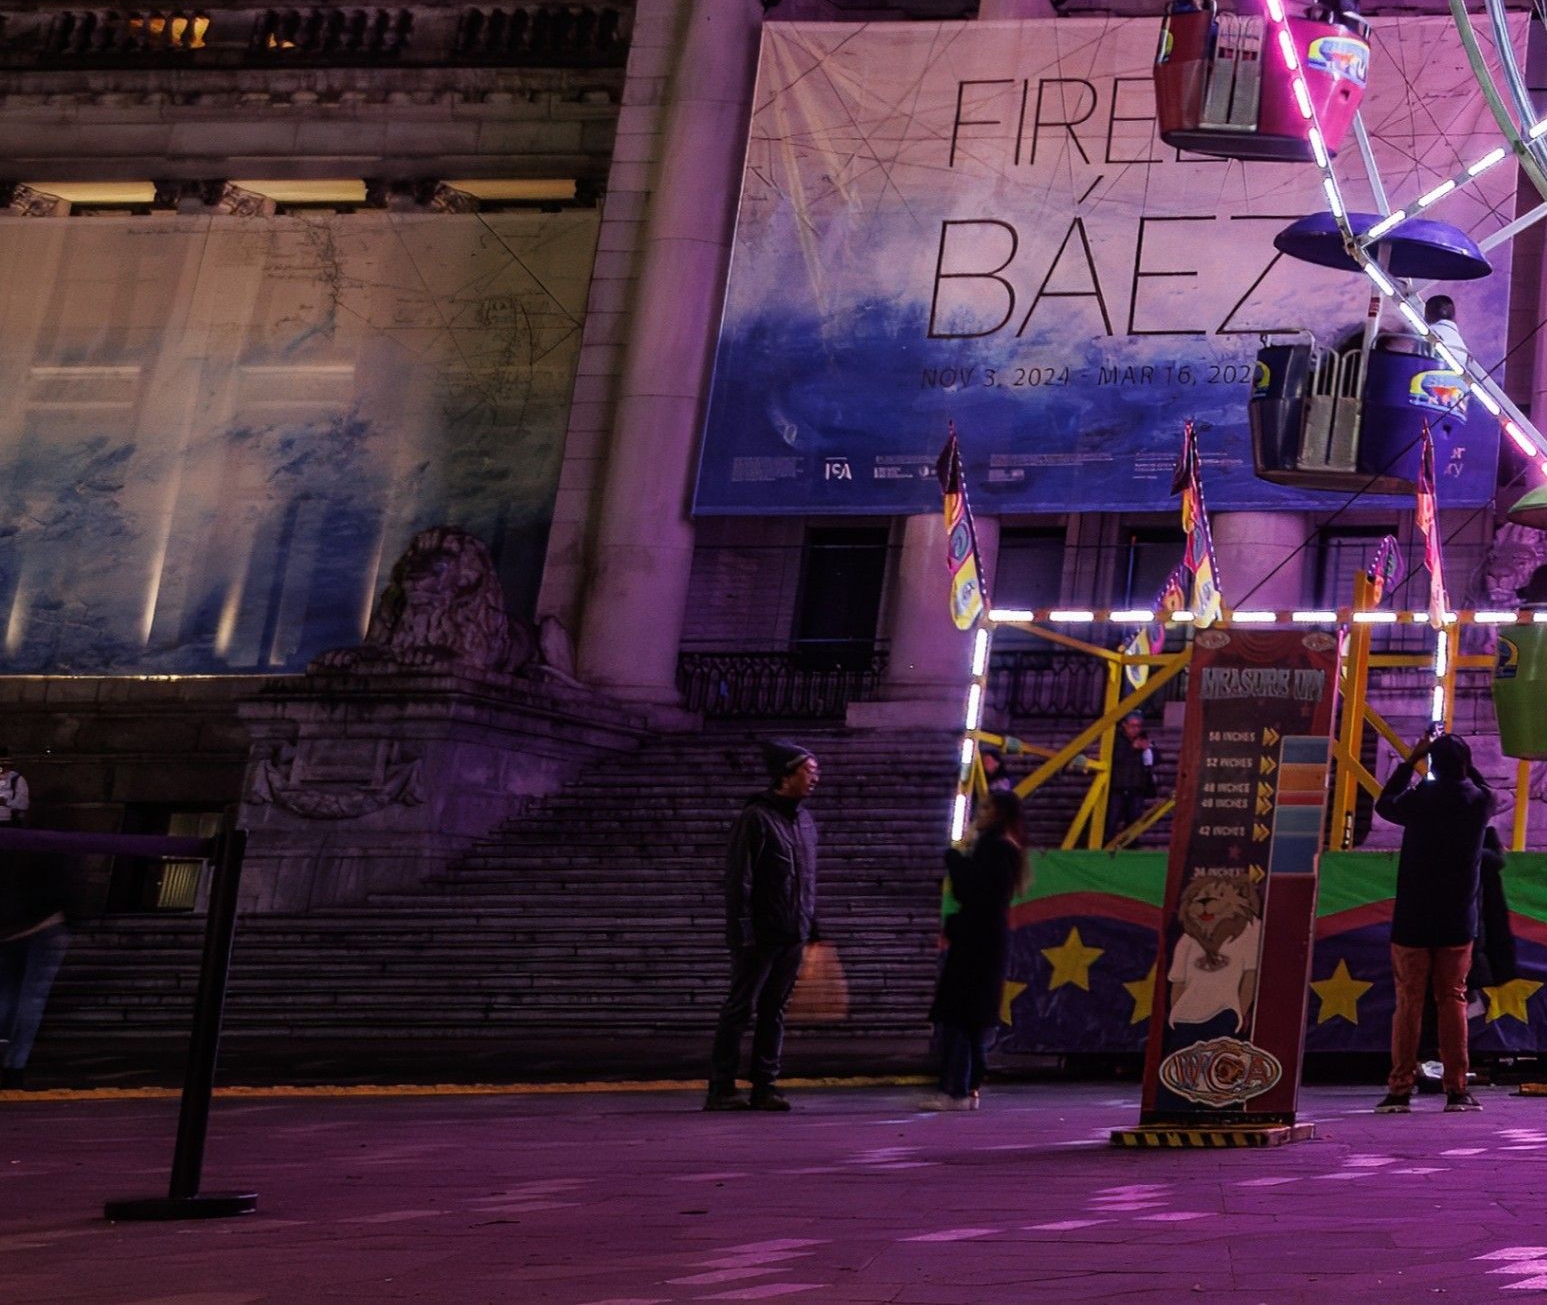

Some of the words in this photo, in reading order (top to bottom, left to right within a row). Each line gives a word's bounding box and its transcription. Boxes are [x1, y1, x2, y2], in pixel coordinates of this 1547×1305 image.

[927, 175, 1310, 341] BÁEZ
[921, 367, 975, 391] NOV
[1013, 367, 1070, 387] 2024
[1098, 366, 1156, 387] MAR
[1165, 365, 1197, 387] 16,
[1207, 365, 1253, 385] 202
[1200, 667, 1291, 700] MEASURE
